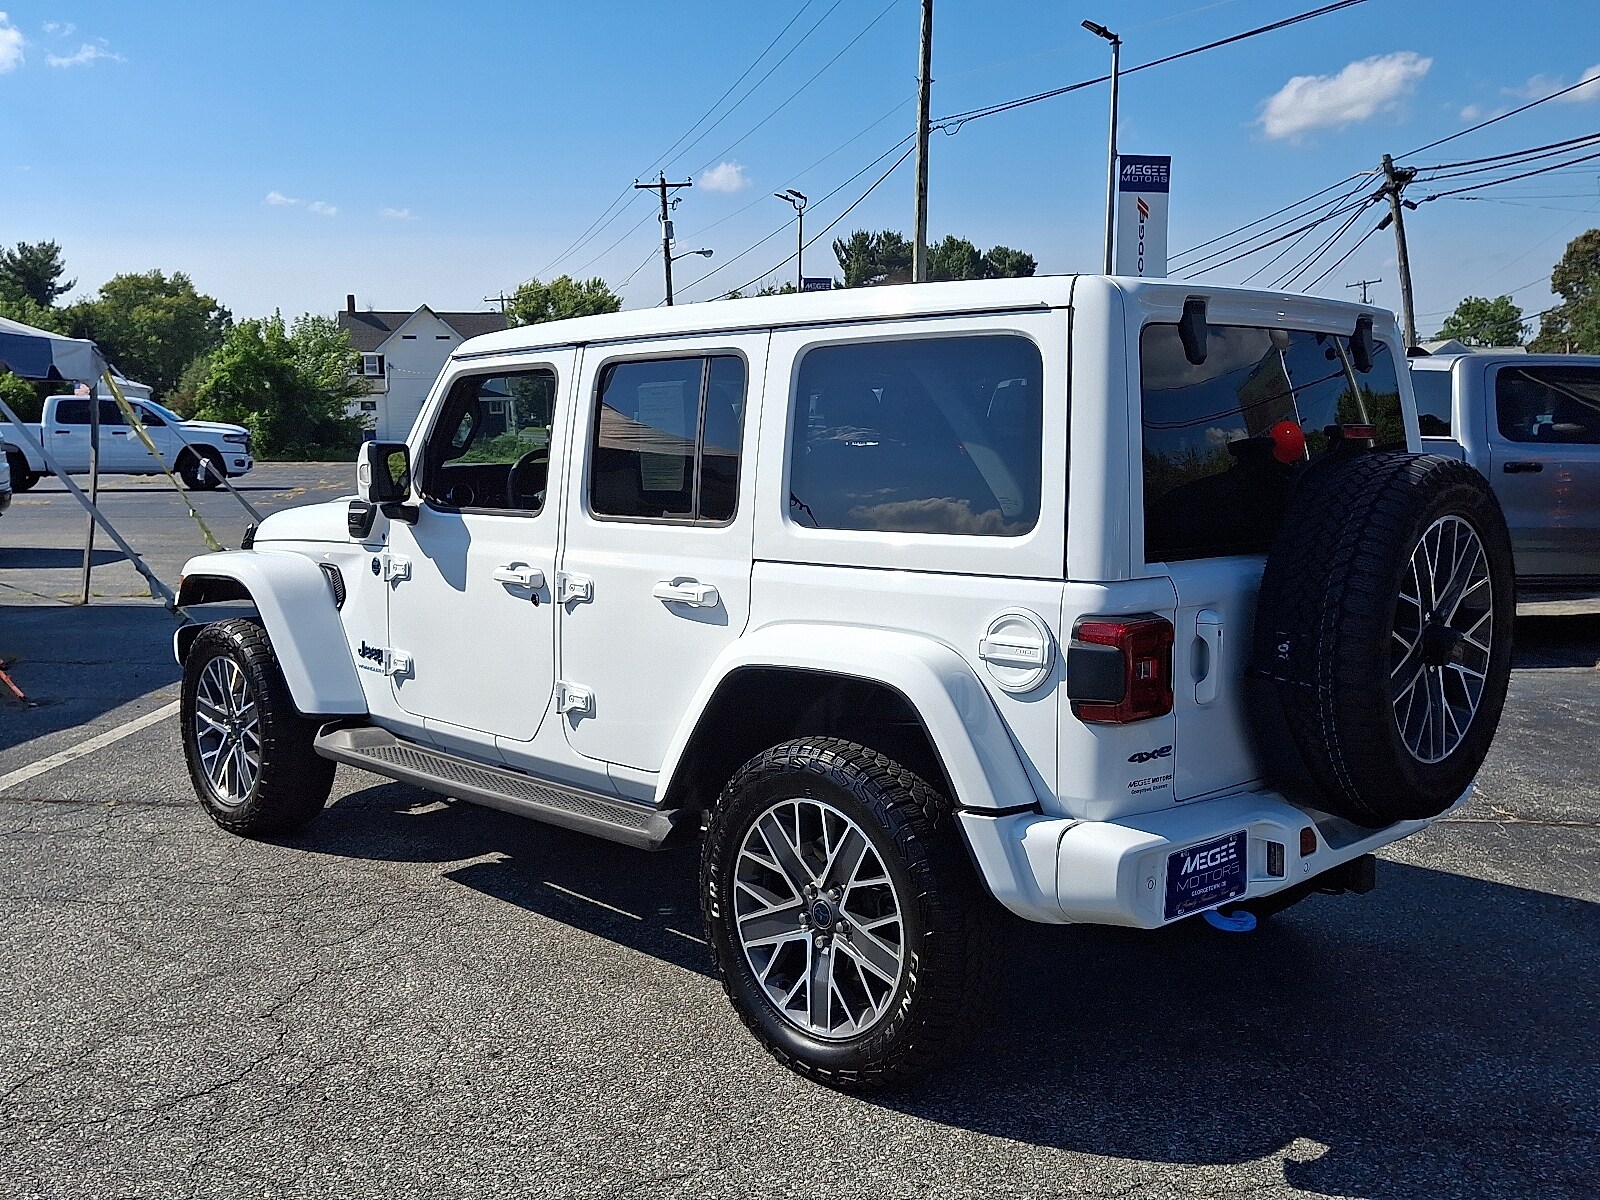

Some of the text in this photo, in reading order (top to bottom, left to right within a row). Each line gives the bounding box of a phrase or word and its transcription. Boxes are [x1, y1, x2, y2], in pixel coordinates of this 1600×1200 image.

[1121, 164, 1168, 175] MEGEE
[1121, 175, 1168, 183] MOTORS
[1137, 211, 1145, 277] ODGE
[805, 282, 831, 290] MEGEE
[358, 640, 383, 666] Jeep
[1128, 745, 1172, 763] 4xe
[1127, 778, 1151, 788] MEGEE
[1181, 841, 1236, 875] MEGEE
[1177, 861, 1239, 892] MOTORS
